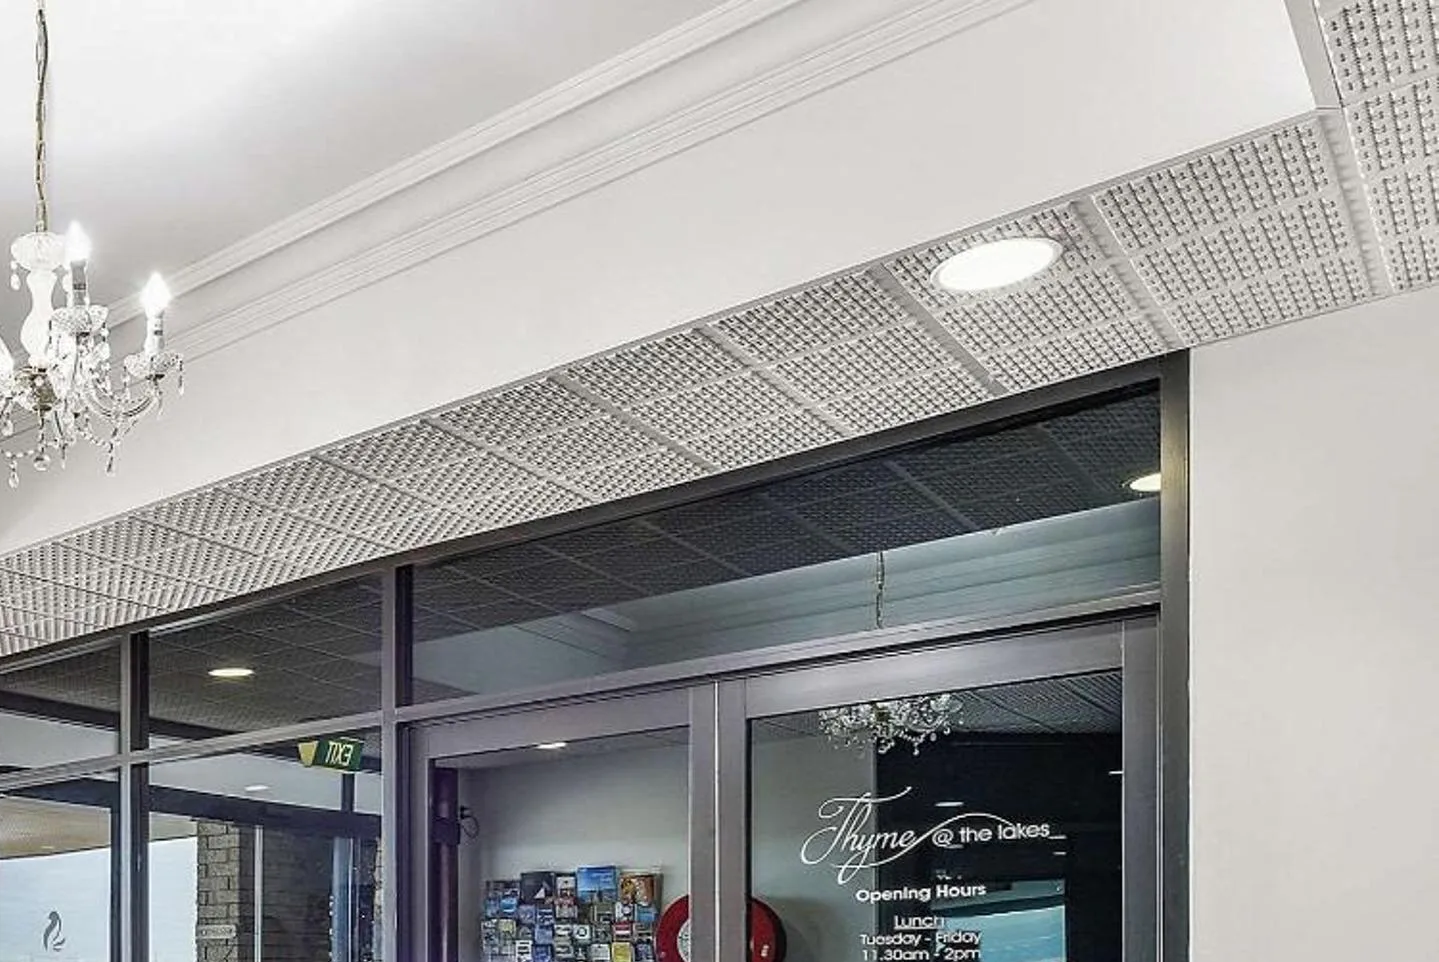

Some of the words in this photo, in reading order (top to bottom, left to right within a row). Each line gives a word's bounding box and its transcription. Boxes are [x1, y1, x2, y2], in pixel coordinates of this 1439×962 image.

[801, 786, 917, 885] Thyme
[932, 828, 954, 847] @
[959, 825, 992, 843] the
[998, 823, 1051, 840] lakes
[856, 886, 931, 904] Opening
[935, 883, 987, 899] Hours
[894, 915, 945, 930] Lunch
[860, 932, 922, 946] Tuesday
[935, 930, 982, 945] Friday
[862, 949, 929, 961] 11.30am
[944, 948, 981, 962] 2pm
